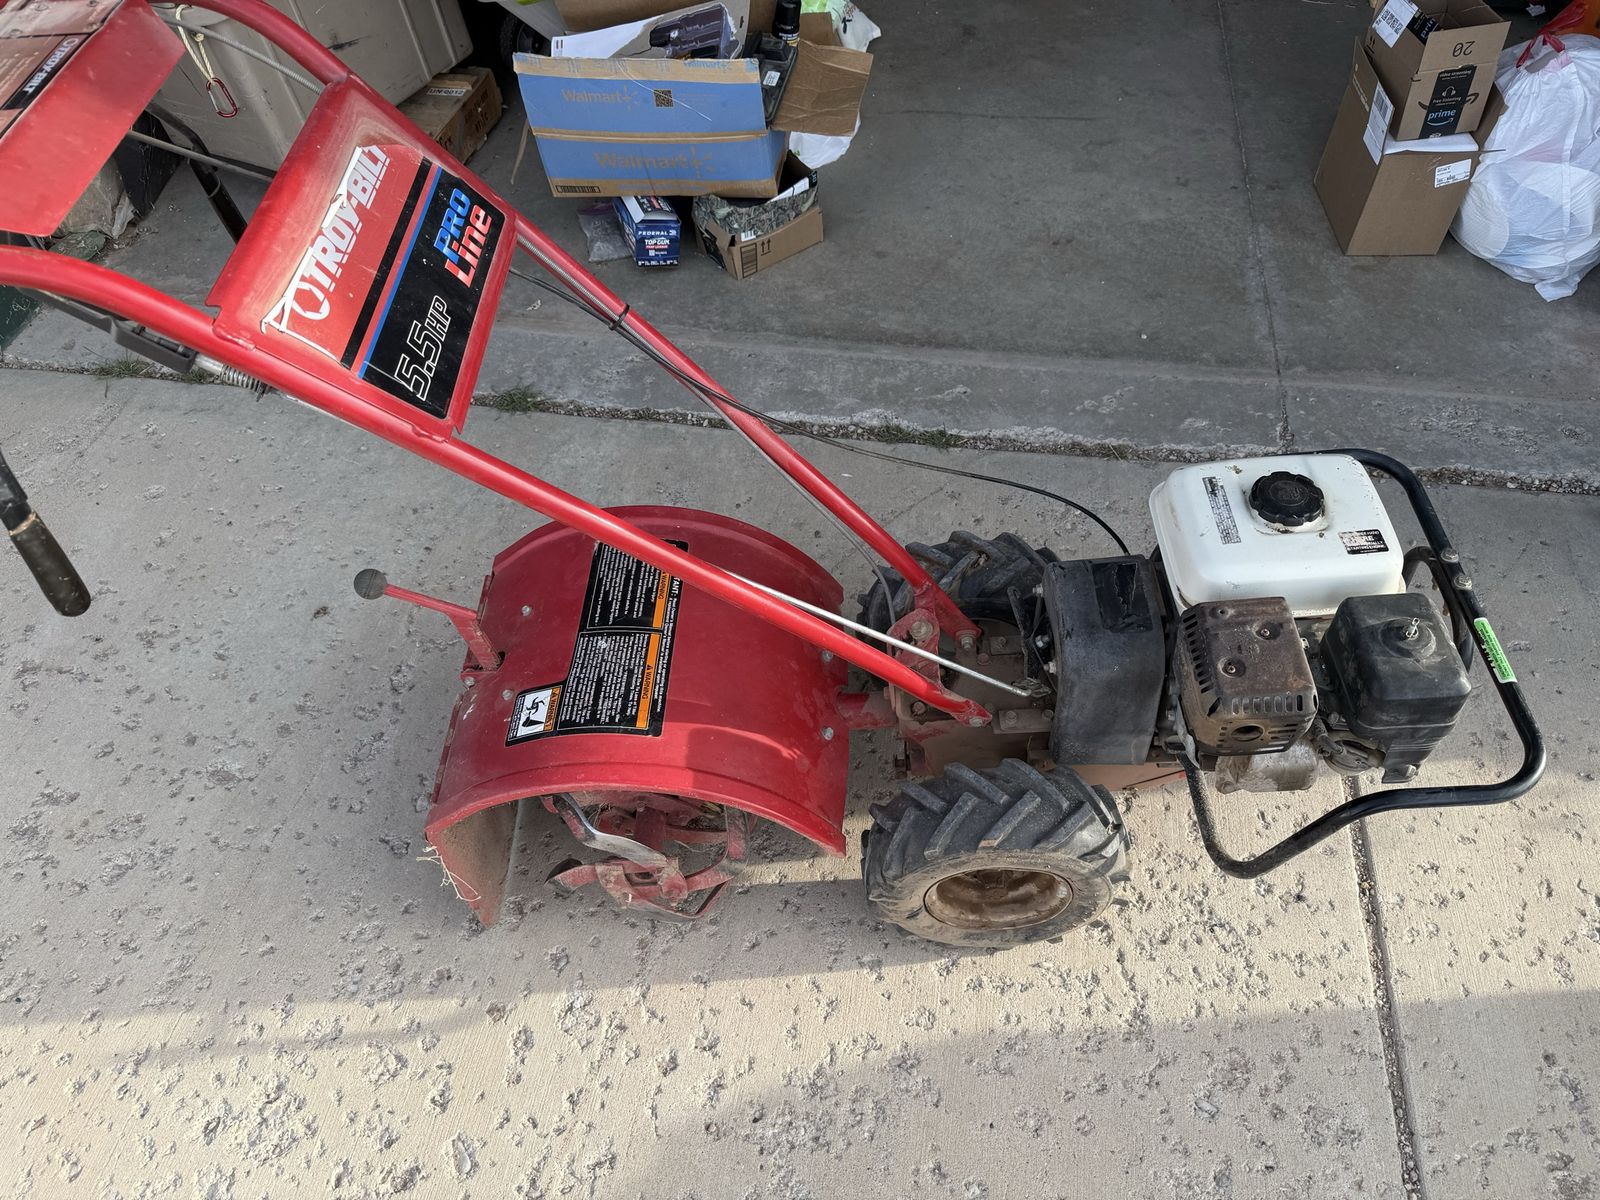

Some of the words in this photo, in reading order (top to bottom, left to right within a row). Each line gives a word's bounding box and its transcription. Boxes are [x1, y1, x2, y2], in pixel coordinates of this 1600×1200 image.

[1453, 41, 1475, 57] 20
[561, 89, 623, 105] Walmart
[1428, 109, 1456, 121] prime
[594, 152, 688, 169] Walmart
[302, 145, 390, 293] TROY-BILT
[433, 188, 471, 264] PRO
[444, 204, 493, 288] Line
[394, 295, 449, 401] 5.5HP
[657, 574, 667, 599] WARNING
[641, 671, 652, 700] WARNING
